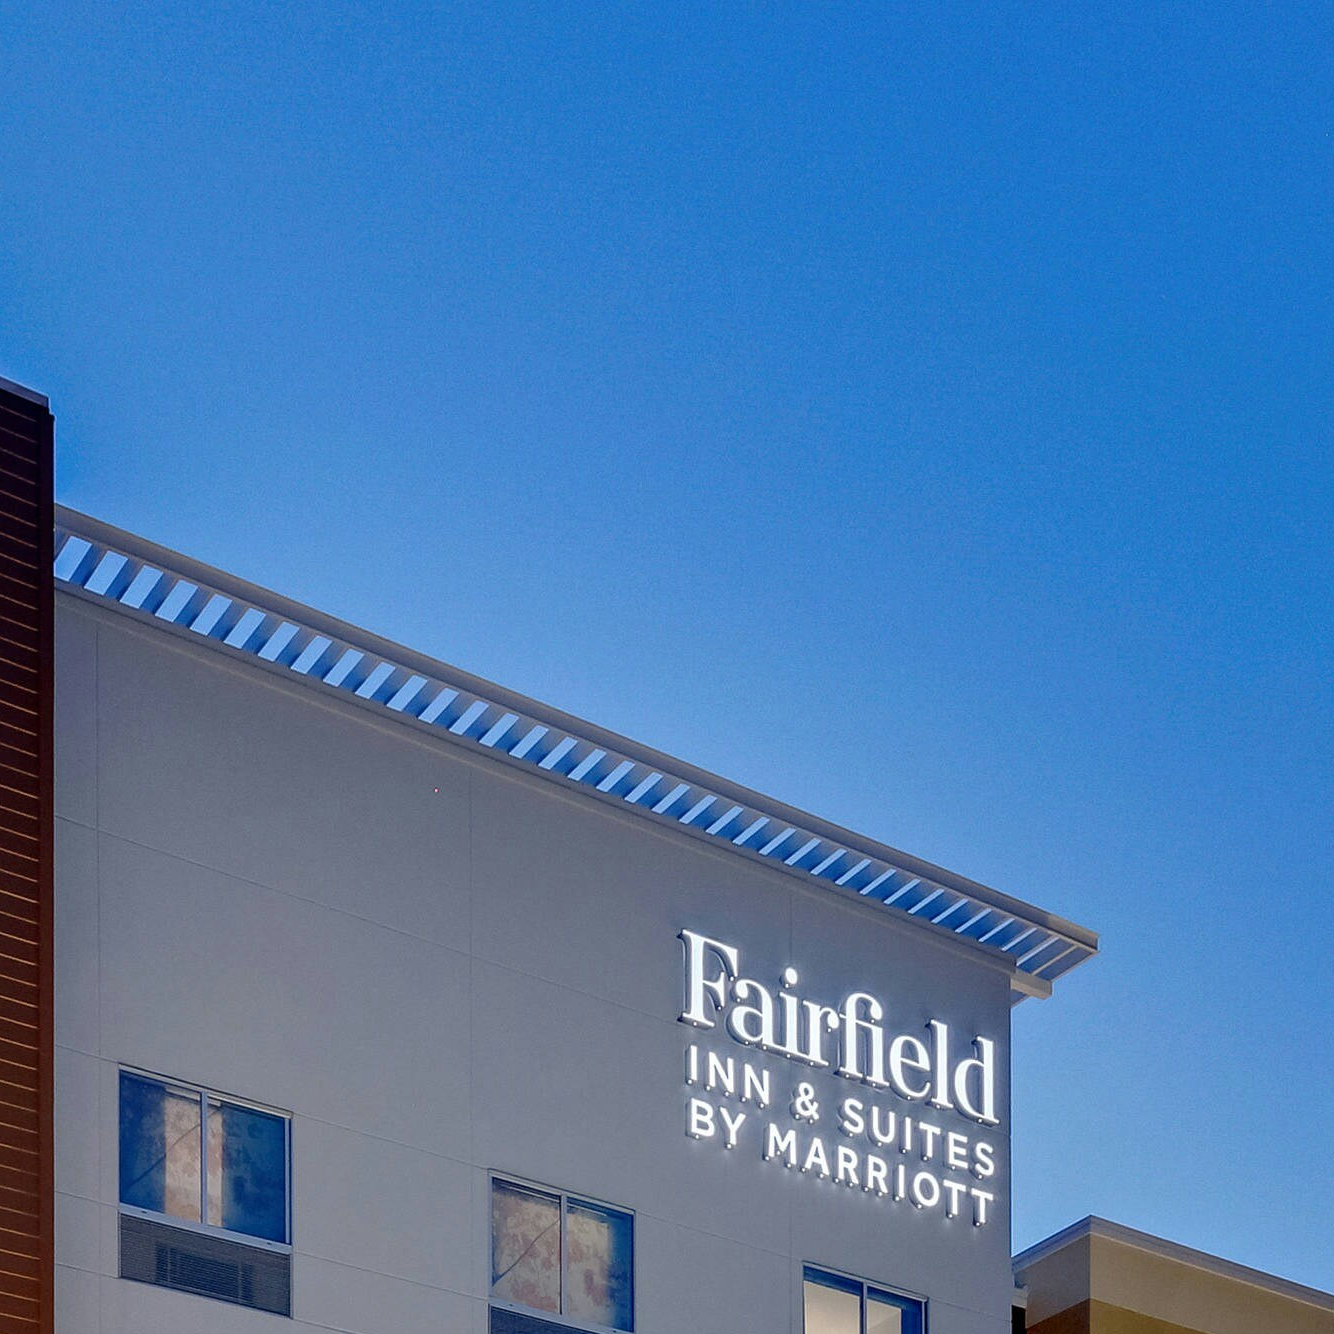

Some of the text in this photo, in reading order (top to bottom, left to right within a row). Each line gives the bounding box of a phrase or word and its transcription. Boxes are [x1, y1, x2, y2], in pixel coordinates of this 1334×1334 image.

[677, 928, 1000, 1125] Fairfield
[686, 1044, 995, 1179] INN & SUITES
[688, 1097, 995, 1226] BY MARRIOTT
